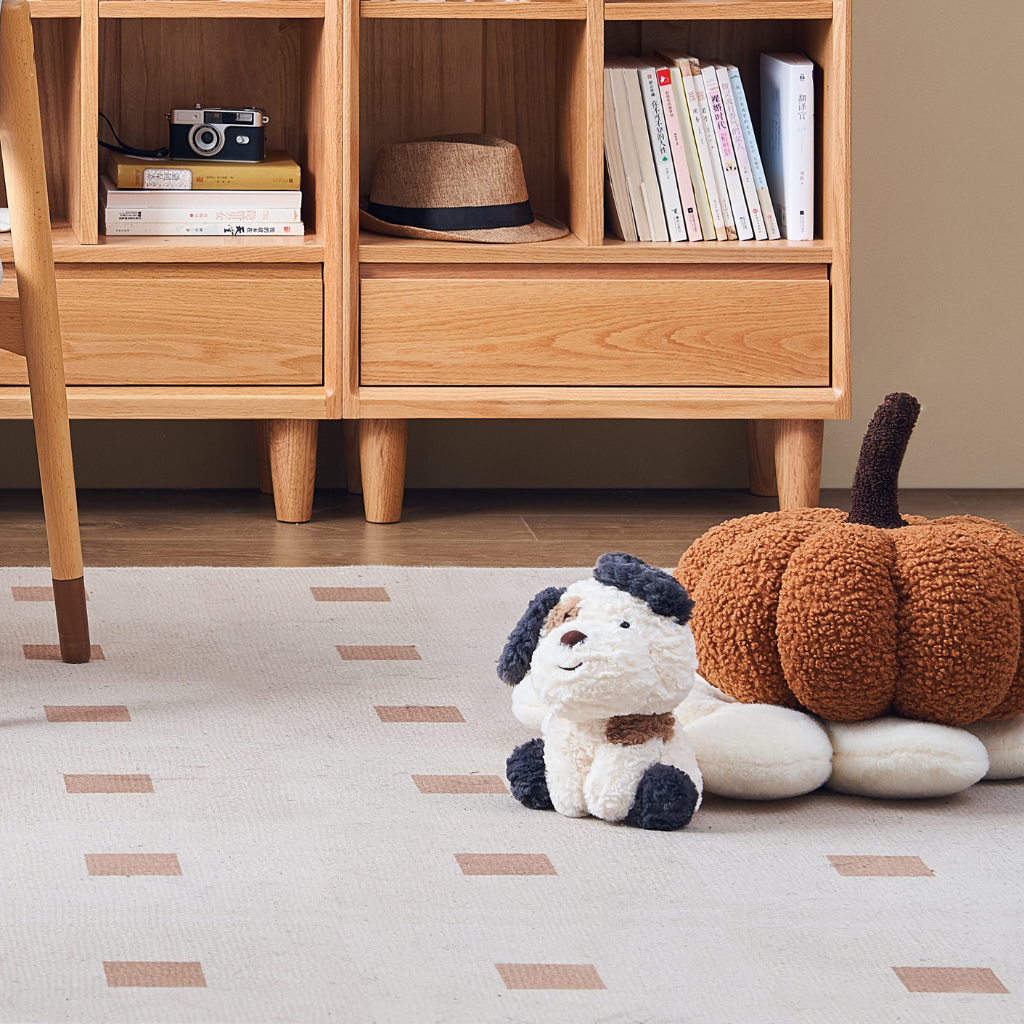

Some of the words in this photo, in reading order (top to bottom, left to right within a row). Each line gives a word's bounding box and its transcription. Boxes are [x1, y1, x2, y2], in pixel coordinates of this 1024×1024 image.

[711, 94, 727, 130] 裸婚时代
[798, 94, 807, 121] 翻译官
